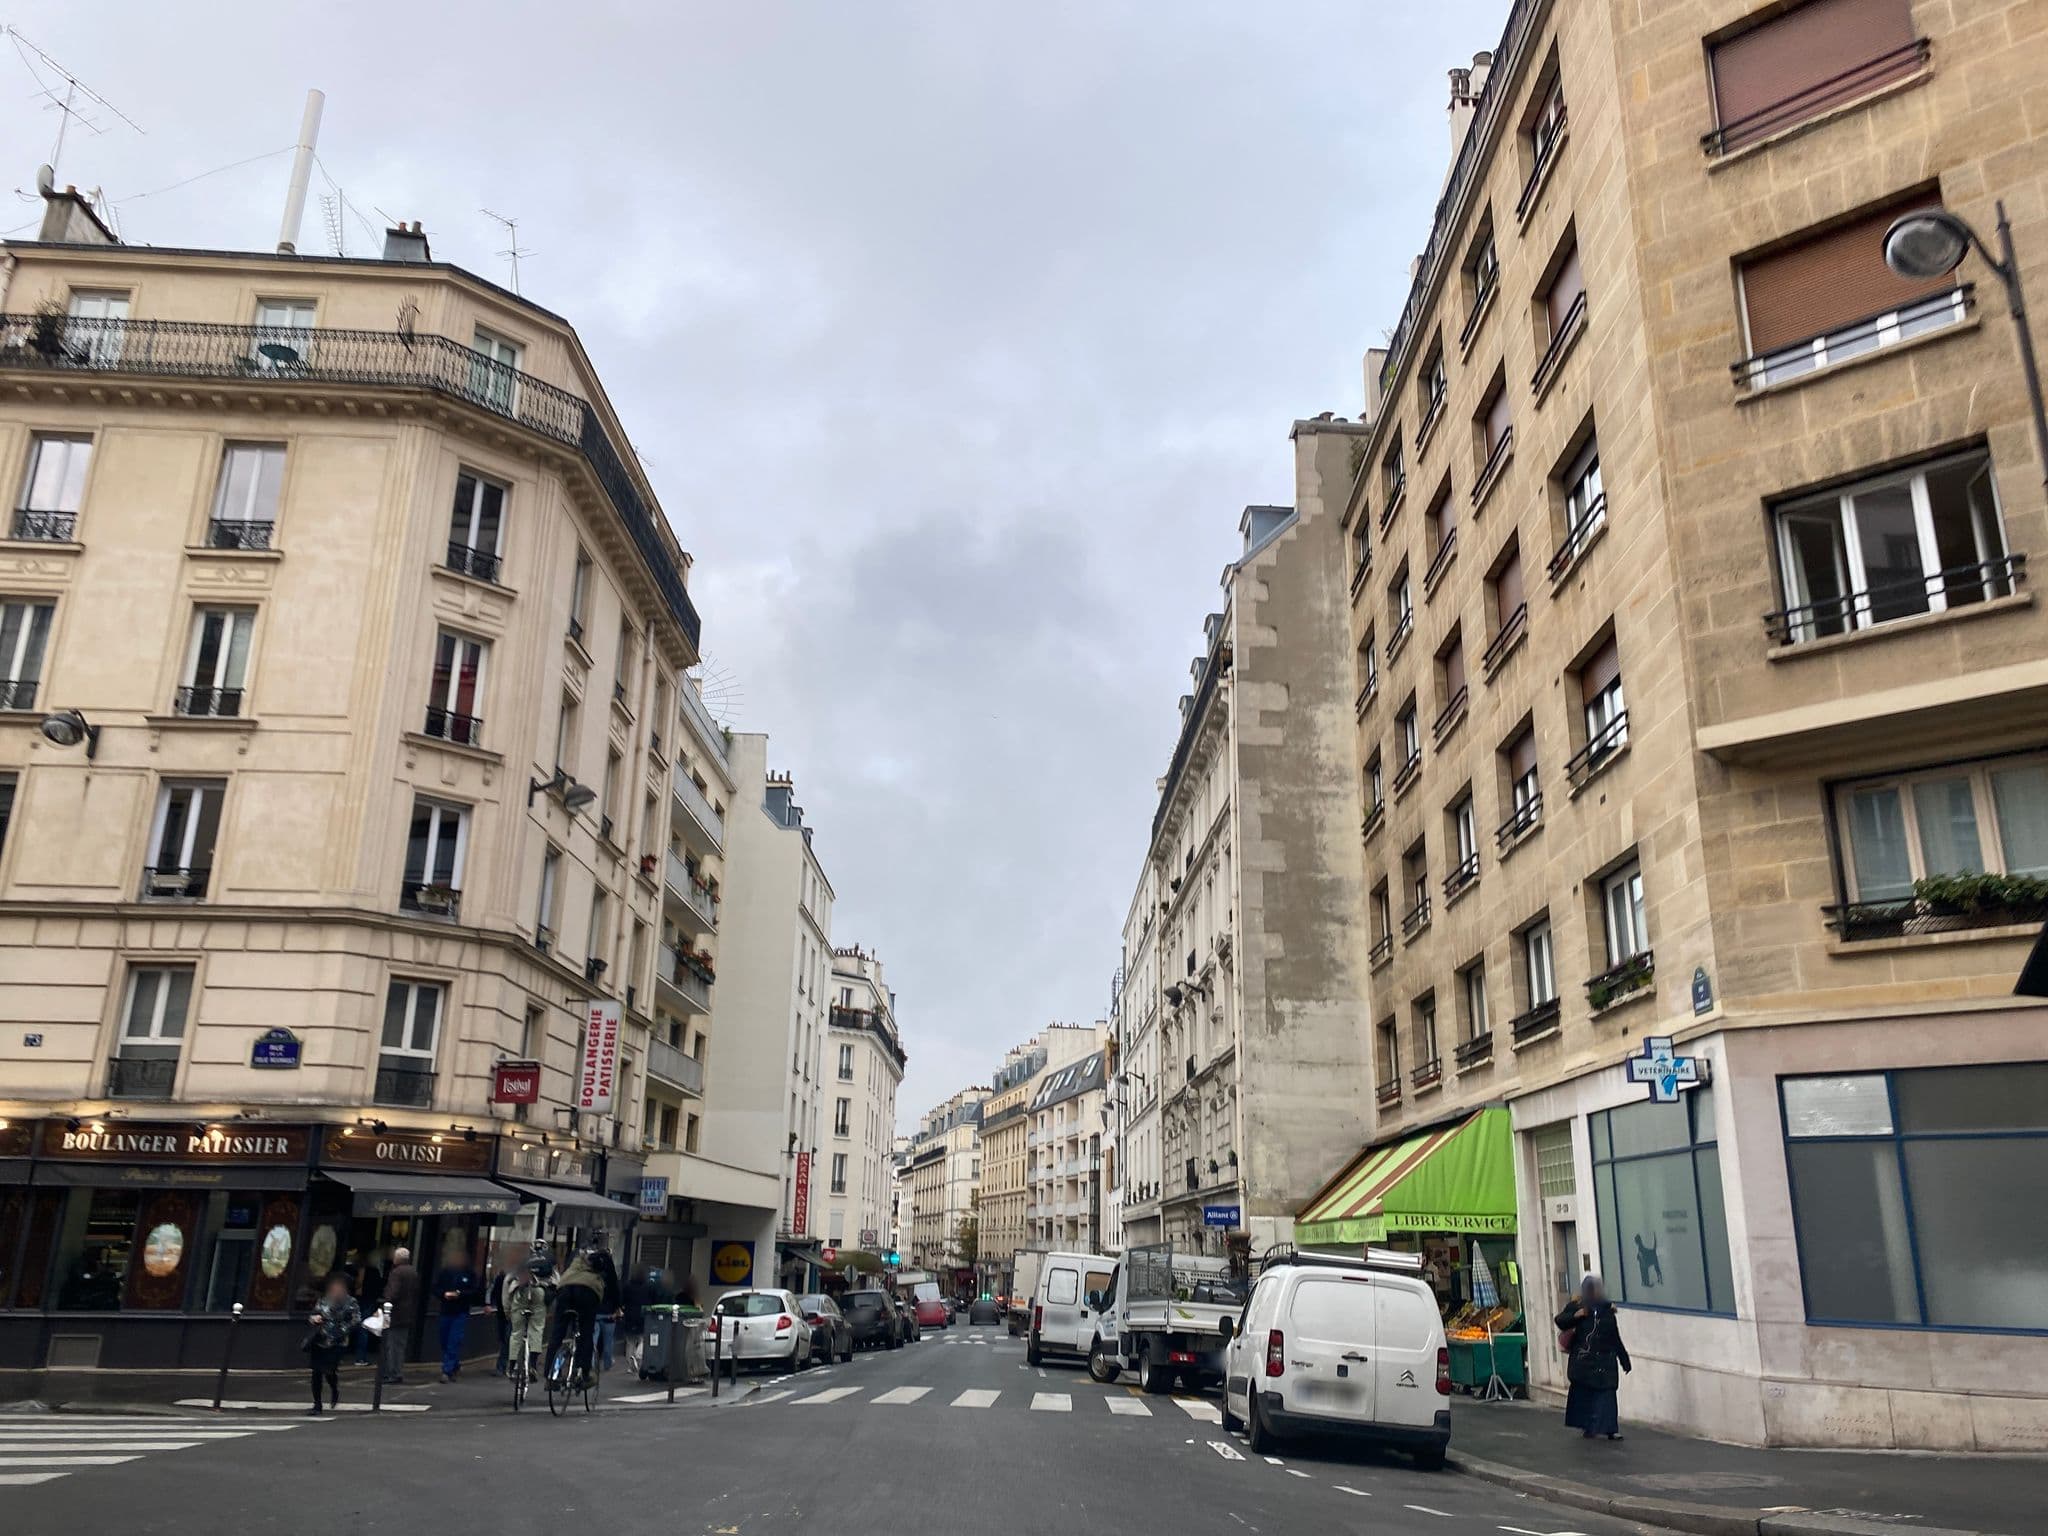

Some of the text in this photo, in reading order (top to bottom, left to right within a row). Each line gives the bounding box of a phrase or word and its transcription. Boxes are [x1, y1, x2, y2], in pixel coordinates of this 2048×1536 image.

[581, 1009, 602, 1107] BOULANGERIE
[599, 1019, 617, 1096] PATISSERIE
[62, 1132, 288, 1154] BOULANGER PATISSIER
[376, 1142, 443, 1163] OUNISSI
[1207, 1211, 1229, 1219] Allianz
[1393, 1215, 1510, 1229] LIBRE SERVICE
